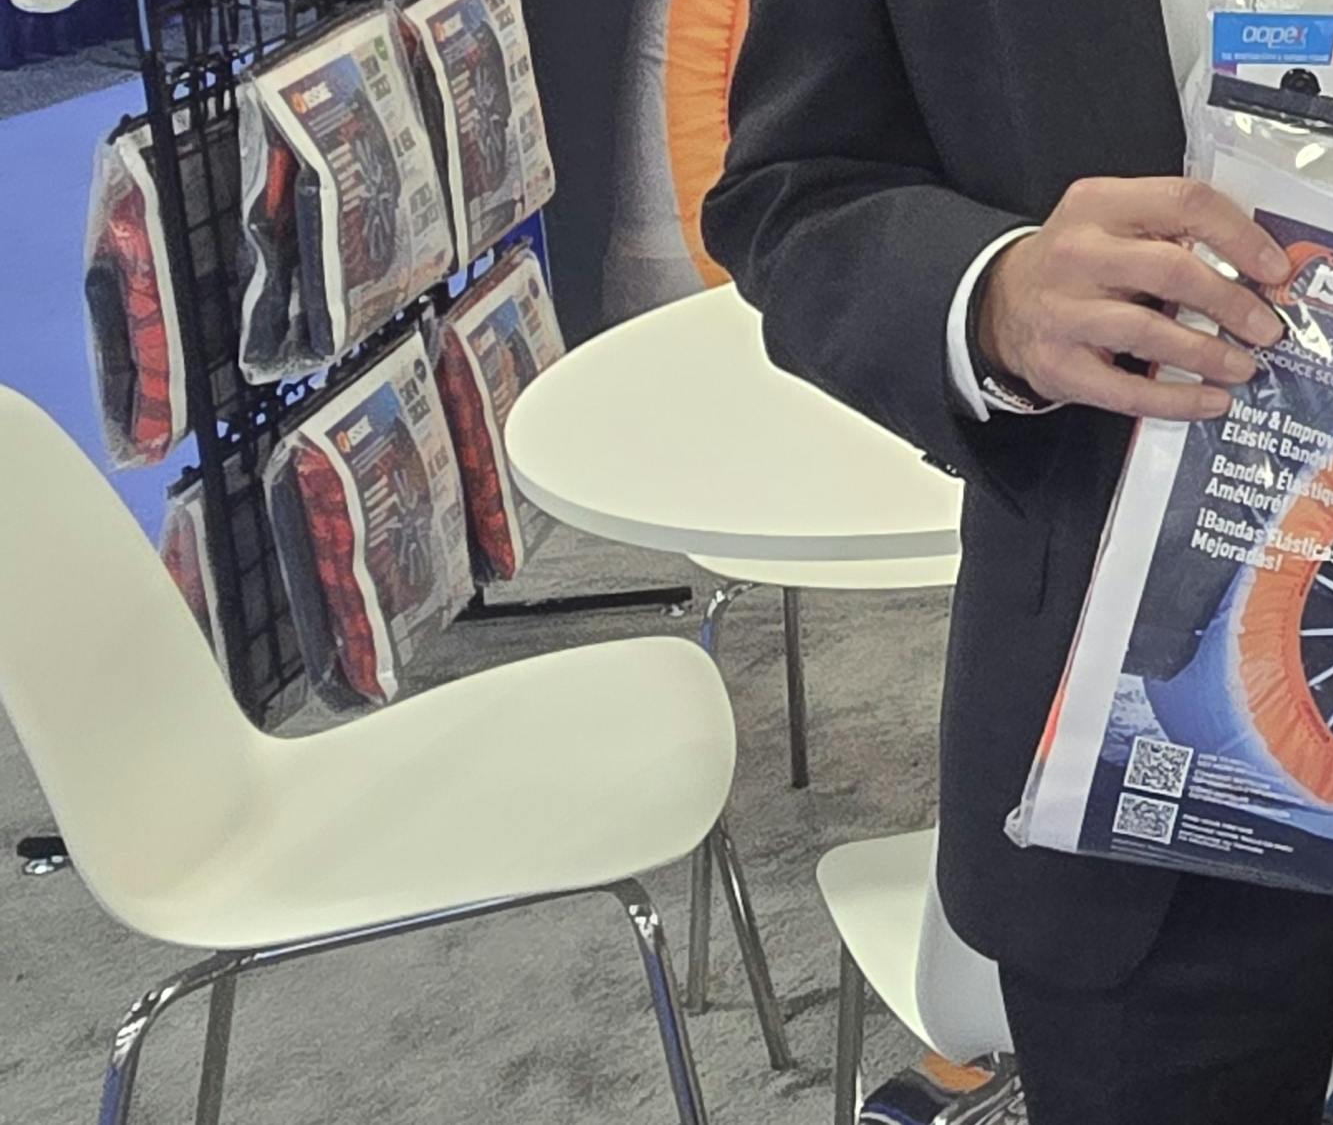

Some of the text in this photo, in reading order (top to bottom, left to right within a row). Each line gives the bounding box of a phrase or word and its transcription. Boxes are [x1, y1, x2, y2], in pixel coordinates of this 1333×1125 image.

[1242, 25, 1308, 49] aapex
[1228, 398, 1268, 426] New
[1268, 411, 1281, 431] &
[1221, 421, 1278, 453] Elastic
